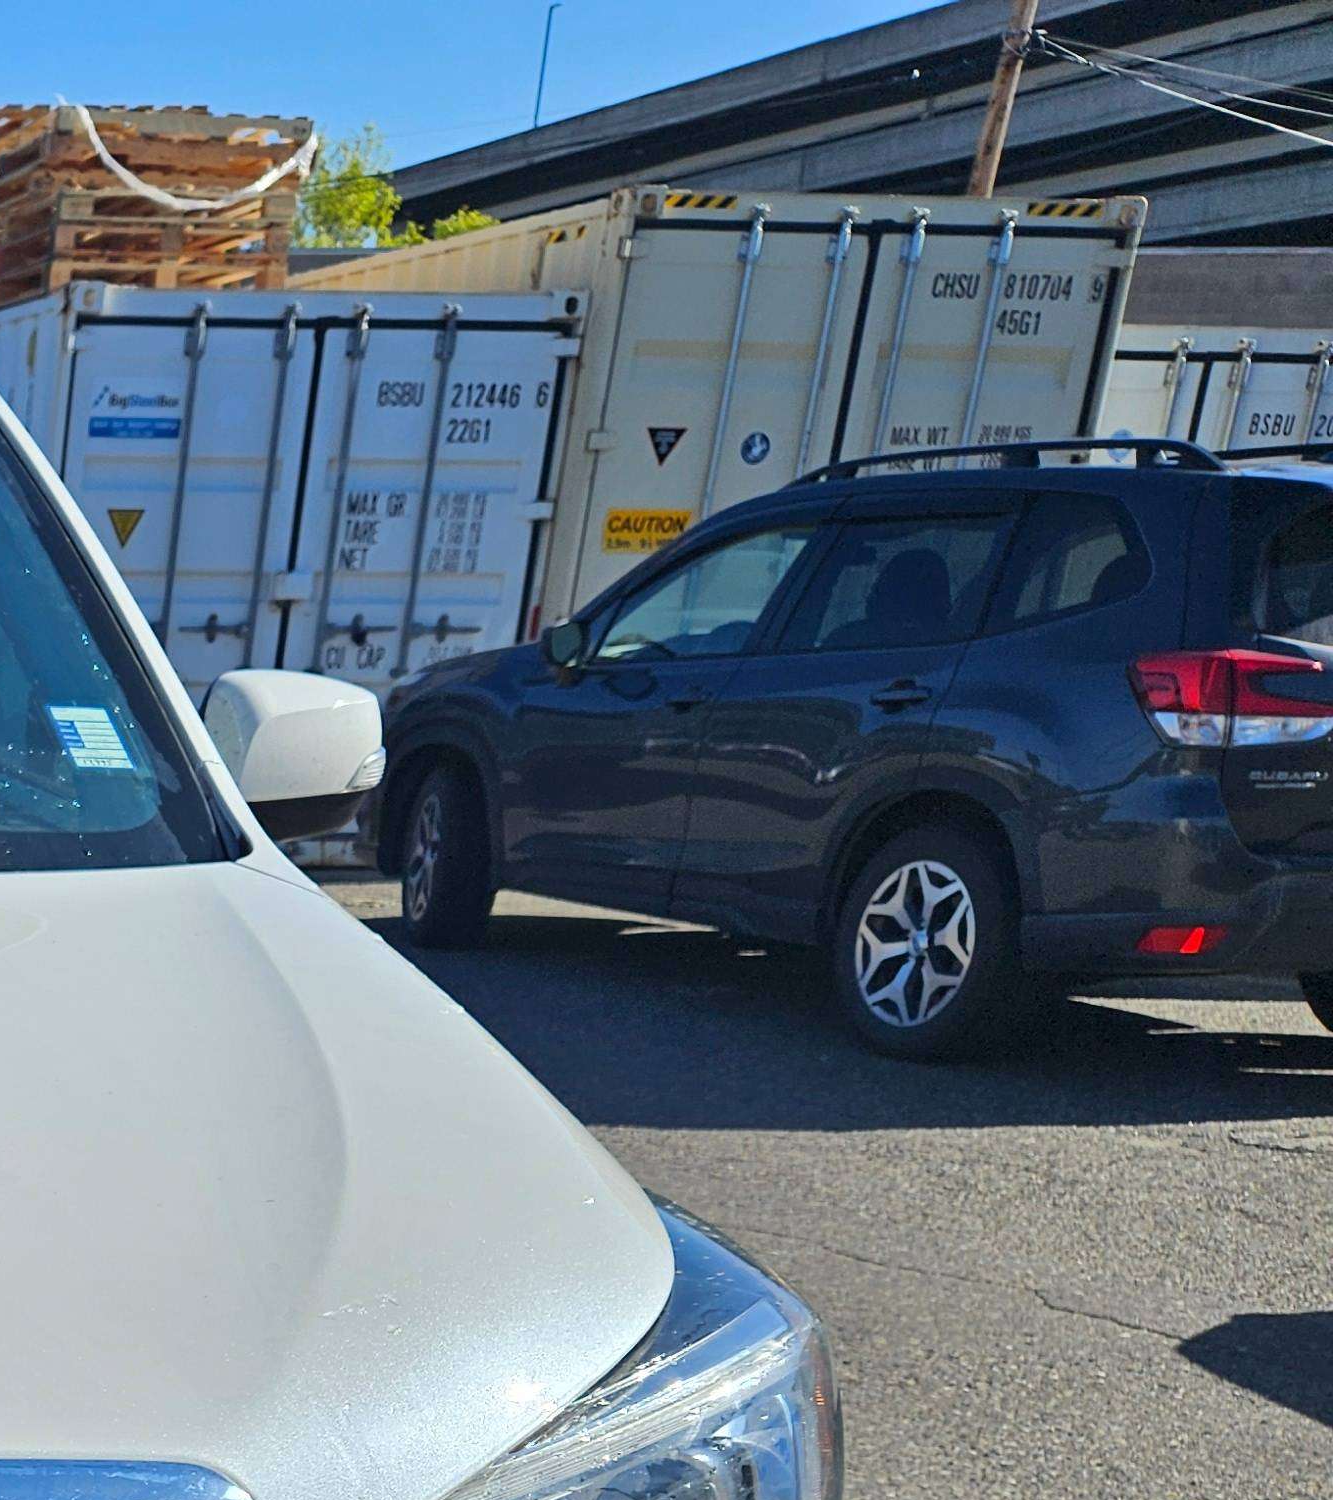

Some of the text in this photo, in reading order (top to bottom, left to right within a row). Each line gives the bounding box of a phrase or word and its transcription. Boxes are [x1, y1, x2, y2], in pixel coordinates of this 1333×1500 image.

[932, 272, 1104, 302] CHSU 810704 9
[995, 309, 1041, 336] 45G1
[377, 381, 550, 409] BSBU 212446 6
[445, 417, 492, 444] 22G1
[889, 425, 921, 446] MAX
[1248, 412, 1296, 437] BSBU
[345, 489, 380, 516] MAX
[344, 518, 381, 545] TARE
[608, 515, 689, 534] CAUTION
[337, 547, 369, 571] NET
